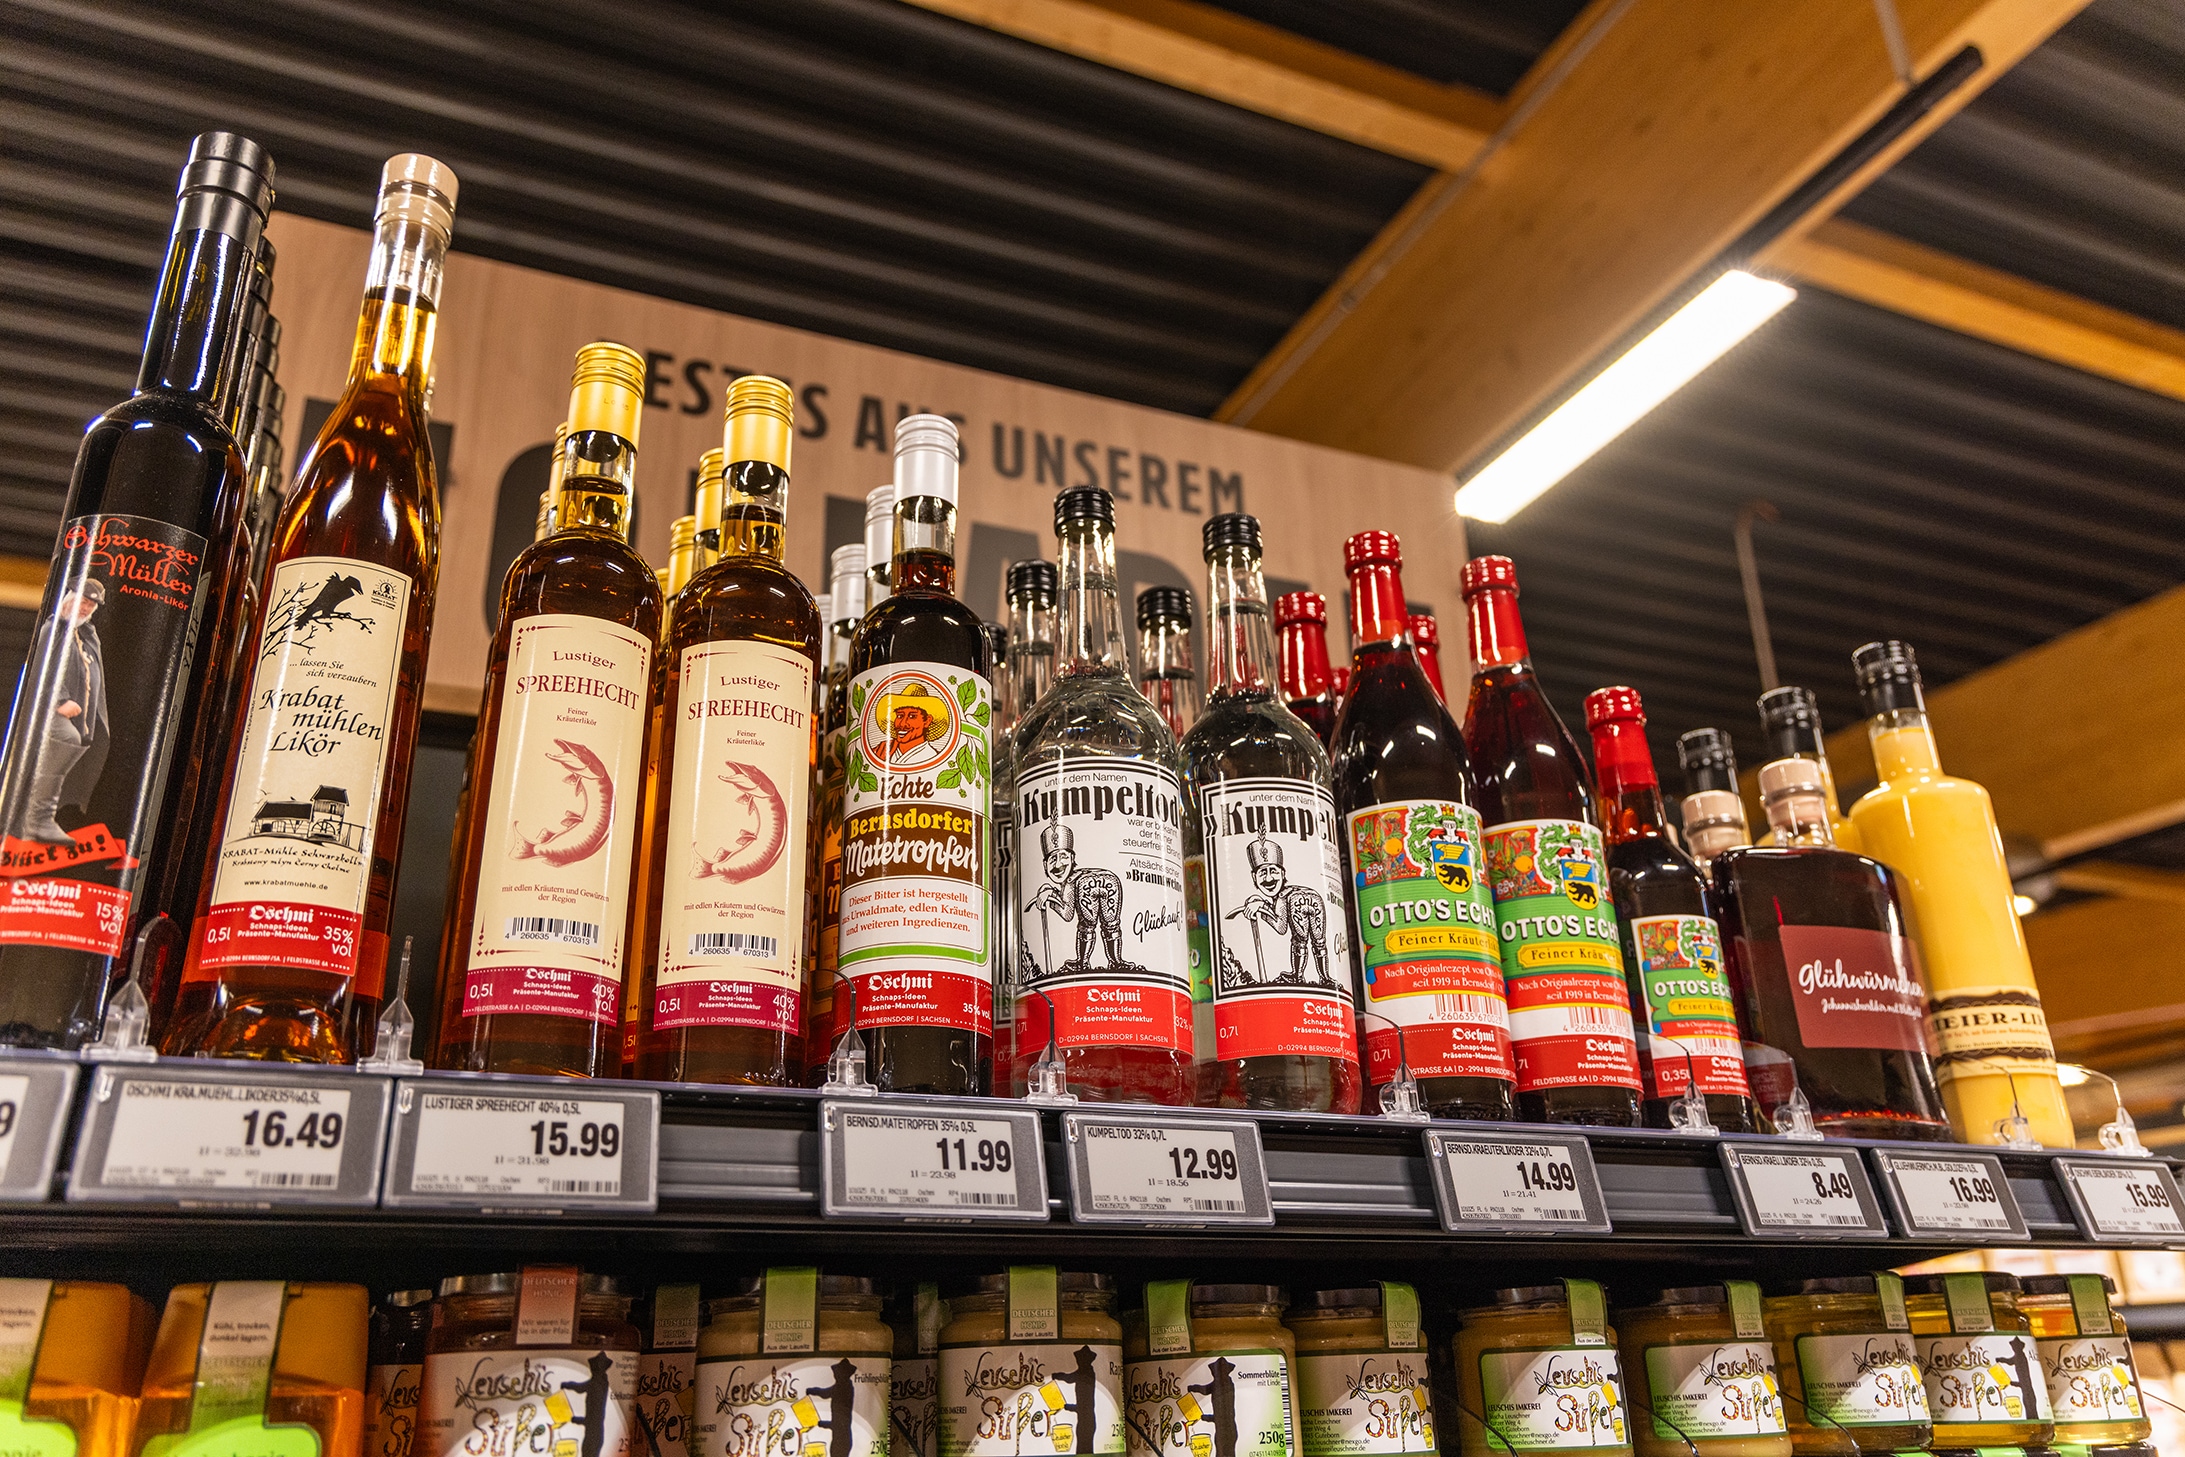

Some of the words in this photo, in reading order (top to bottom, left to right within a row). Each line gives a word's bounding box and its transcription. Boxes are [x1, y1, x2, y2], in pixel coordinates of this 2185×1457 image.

[992, 420, 1246, 517] UNSEREM
[63, 517, 199, 566] Schwarzer
[84, 550, 193, 595] Müller
[119, 584, 190, 611] Aronia-Likör
[300, 658, 328, 669] lassen
[328, 660, 345, 671] Sie
[552, 650, 616, 670] Lustiger
[306, 669, 325, 678] sich
[327, 669, 377, 688] verzaubern
[720, 674, 781, 692] Lustiger
[258, 685, 346, 712] Krabat
[515, 674, 640, 711] SPREEHECHT
[567, 707, 589, 717] Feiner
[291, 709, 383, 741] mühlen
[556, 714, 598, 727] Kräuterlikör
[736, 730, 757, 738] Feiner
[268, 729, 343, 758] Likör
[726, 737, 766, 747] Kräuterlikör
[1068, 774, 1091, 783] dem
[1092, 773, 1128, 782] Namen
[880, 774, 935, 800] Echte
[1249, 794, 1274, 803] unter
[850, 808, 973, 840] Bernsdorfer
[1127, 817, 1144, 827] war
[222, 846, 299, 860] KRABAT-Mühle
[845, 835, 979, 877] Matetropfen
[243, 879, 329, 891] www.krabatmuehle.de
[501, 885, 513, 893] mit
[534, 884, 565, 894] Kräutern
[566, 887, 579, 895] und
[580, 889, 610, 902] Gewürzen
[538, 893, 550, 901] der
[551, 894, 577, 905] Region
[848, 894, 872, 907] Dieser
[874, 890, 901, 900] Bitter
[903, 889, 916, 899] ist
[918, 888, 969, 904] hergestellt
[96, 901, 125, 922] 15%
[249, 904, 314, 924] Oschmi
[714, 902, 743, 912] Kräutern
[744, 903, 757, 911] und
[757, 904, 786, 916] Gewürzen
[730, 910, 755, 920] Region
[850, 904, 907, 920] Urwaldmate,
[909, 902, 938, 912] edlen
[940, 904, 979, 921] Kräutern
[1369, 899, 1451, 928] OTTO'S
[100, 919, 122, 936] vol
[250, 922, 309, 933] Schnaps-Ideen
[860, 918, 899, 931] weiteren
[902, 917, 971, 933] Ingredienzen.
[1501, 915, 1581, 942] OTTO'S
[207, 927, 231, 944] 0,5l
[236, 929, 320, 942] Präsente-Manufaktur
[323, 926, 354, 945] 35%
[520, 932, 550, 940] 260635
[563, 934, 590, 945] 670313
[1399, 933, 1443, 947] Feiner
[331, 943, 352, 958] vol
[1531, 950, 1574, 961] Feiner
[525, 968, 572, 982] Oschmi
[1384, 967, 1405, 979] Nach
[1406, 964, 1471, 977] Originalrezept
[523, 981, 571, 991] Schnaps-Ideen
[709, 981, 753, 996] Oschmi
[867, 973, 933, 993] Oschmi
[1412, 977, 1429, 988] seit
[1431, 977, 1451, 987] 1919
[1518, 981, 1539, 991] Nach
[1540, 977, 1600, 990] Originalrezept
[1654, 980, 1710, 997] OTTO'S
[469, 983, 493, 999] 0,5l
[513, 988, 580, 999] Präsente-Manufaktur
[591, 983, 615, 1001] 40%
[708, 994, 753, 1003] Schnaps-Ideen
[871, 992, 927, 1003] Schnaps-Ideen
[1086, 988, 1141, 1004] Oschmi
[1565, 990, 1583, 1000] 1919
[659, 998, 681, 1014] 0,5l
[699, 1001, 761, 1010] Präsente-Manufaktur
[773, 994, 795, 1011] 40%
[862, 1002, 939, 1013] Präsente-Manufaktur
[1086, 1006, 1142, 1014] Schnaps-Ideen
[876, 1016, 915, 1024] BERNSDORF
[920, 1016, 951, 1024] SACHSEN
[1075, 1015, 1153, 1024] Präsente-Manufaktur
[1059, 1034, 1089, 1044] D-02994
[1091, 1033, 1133, 1041] BERNSDORF
[1139, 1034, 1169, 1043] SACHSEN
[1219, 1026, 1238, 1039] 0,7l
[1452, 1027, 1495, 1043] Oschmi
[1373, 1049, 1391, 1062] 0,7l
[1533, 1076, 1577, 1086] FELDSTRASSE
[425, 1096, 473, 1111] LUSTIGER
[475, 1098, 536, 1112] SPREEHECHT
[538, 1101, 561, 1114] 40%
[562, 1103, 581, 1116] 0,5L
[243, 1109, 343, 1149] 16.49
[846, 1115, 939, 1131] BERNSD.MATETROPFEN
[940, 1120, 959, 1133] 35%
[960, 1121, 977, 1134] 0,5L
[530, 1120, 620, 1158] 15.99
[1087, 1126, 1132, 1140] KUMPELTOD
[1133, 1129, 1151, 1141] 32%
[1151, 1130, 1167, 1142] 0,7L
[936, 1137, 1012, 1172] 11.99
[1446, 1143, 1526, 1157] BERNSD.KRAEUTERLIKOER
[1525, 1145, 1540, 1157] 32%
[1169, 1147, 1238, 1180] 12.99
[929, 1170, 957, 1180] 23.98
[1166, 1178, 1189, 1187] 18.56
[1516, 1161, 1576, 1192] 14.99
[1811, 1171, 1853, 1199] 8.49
[1949, 1176, 1996, 1204] 16.99
[1516, 1190, 1537, 1198] 21.41
[2126, 1183, 2170, 1208] 15.99
[1012, 1309, 1055, 1318] DEUTSCHER
[765, 1320, 813, 1330] DEUTSCHER
[1020, 1320, 1047, 1330] HONIG
[1238, 1369, 1279, 1380] Sommerblüte
[1267, 1379, 1280, 1387] Linde
[1326, 1408, 1353, 1416] IMKEREI
[1258, 1431, 1285, 1448] 250g
